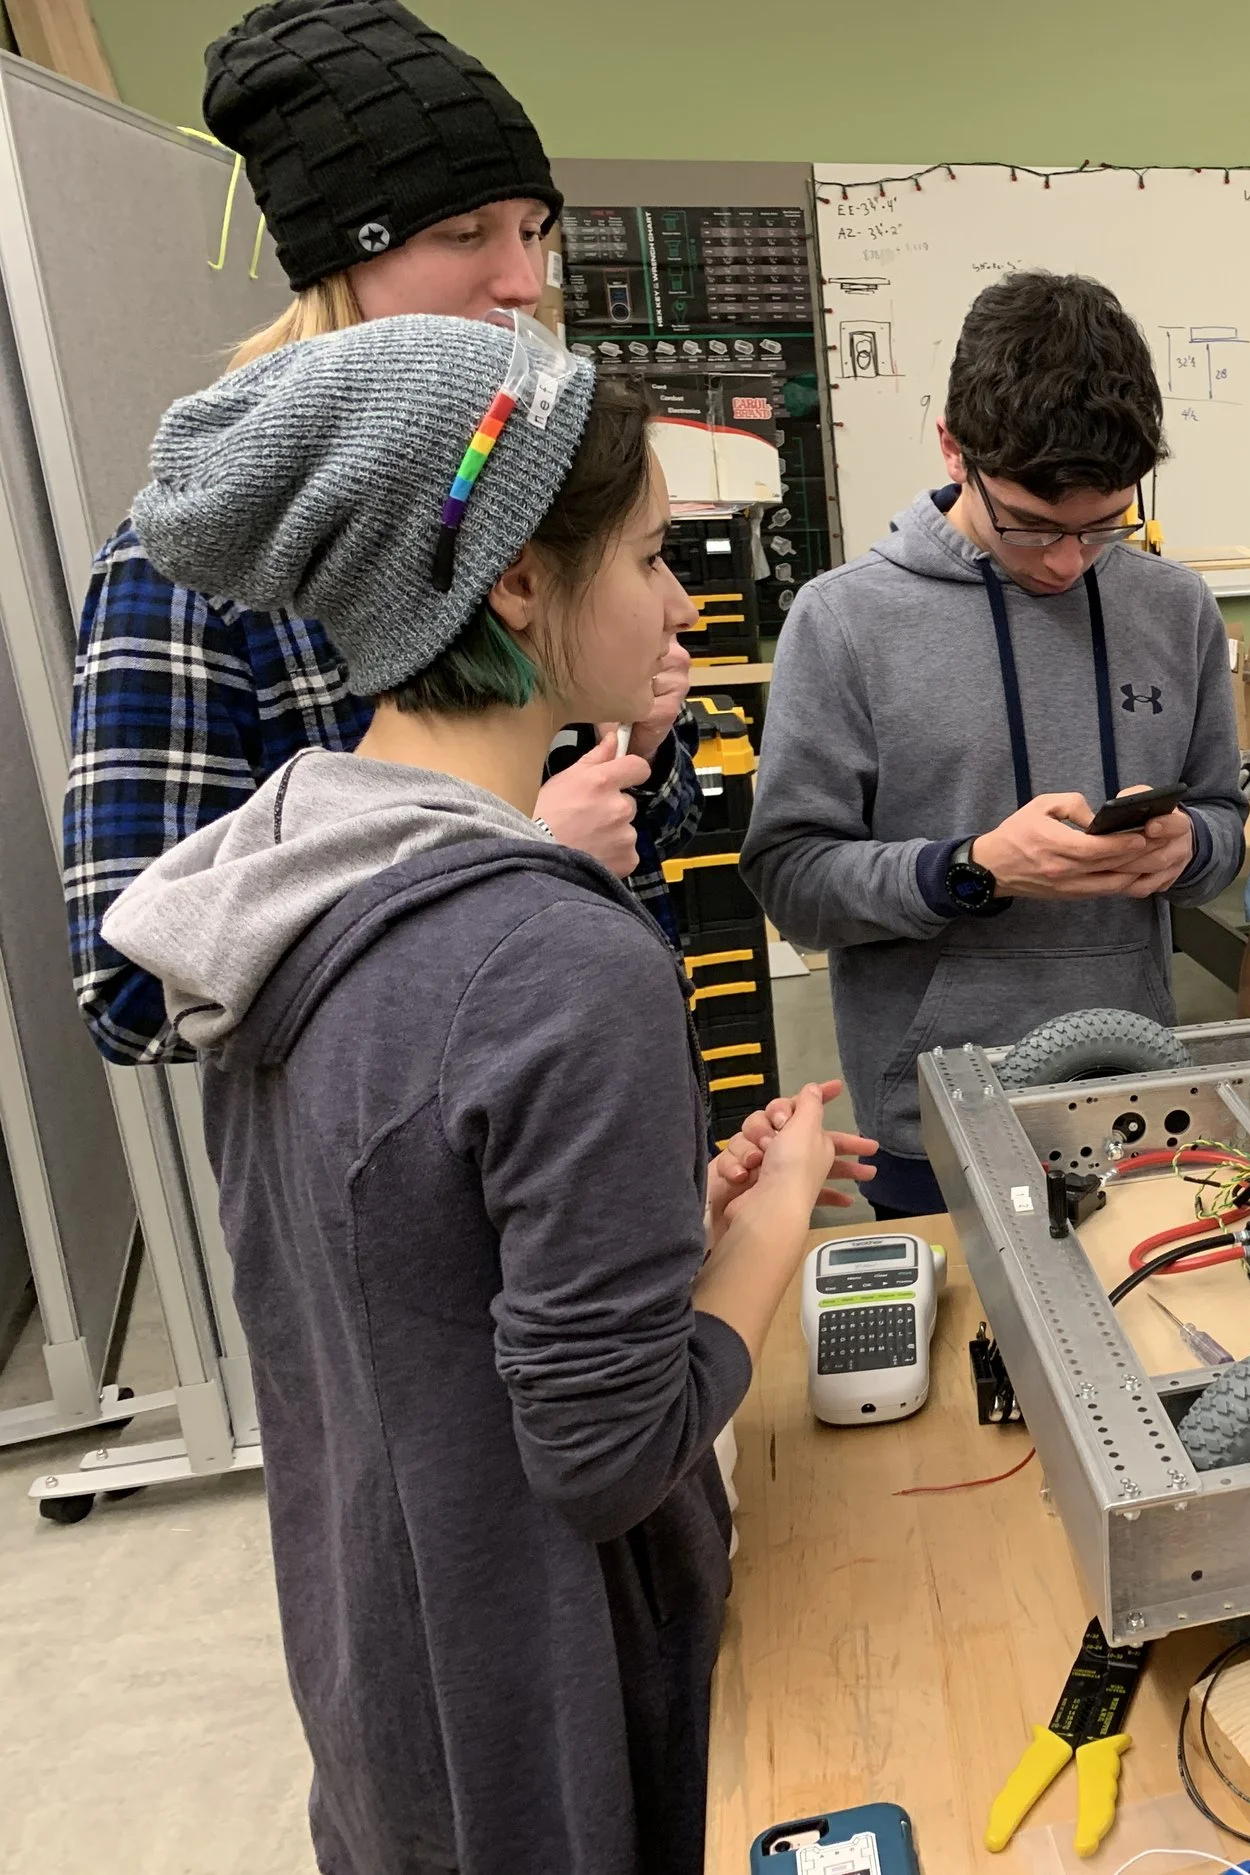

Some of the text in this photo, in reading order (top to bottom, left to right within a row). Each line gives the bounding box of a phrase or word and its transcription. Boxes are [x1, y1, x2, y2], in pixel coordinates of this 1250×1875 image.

[645, 211, 654, 242] CHART
[649, 243, 658, 282] WRENCH
[1215, 369, 1227, 380] 28
[733, 398, 768, 409] CAROL
[734, 409, 771, 418] BRAND
